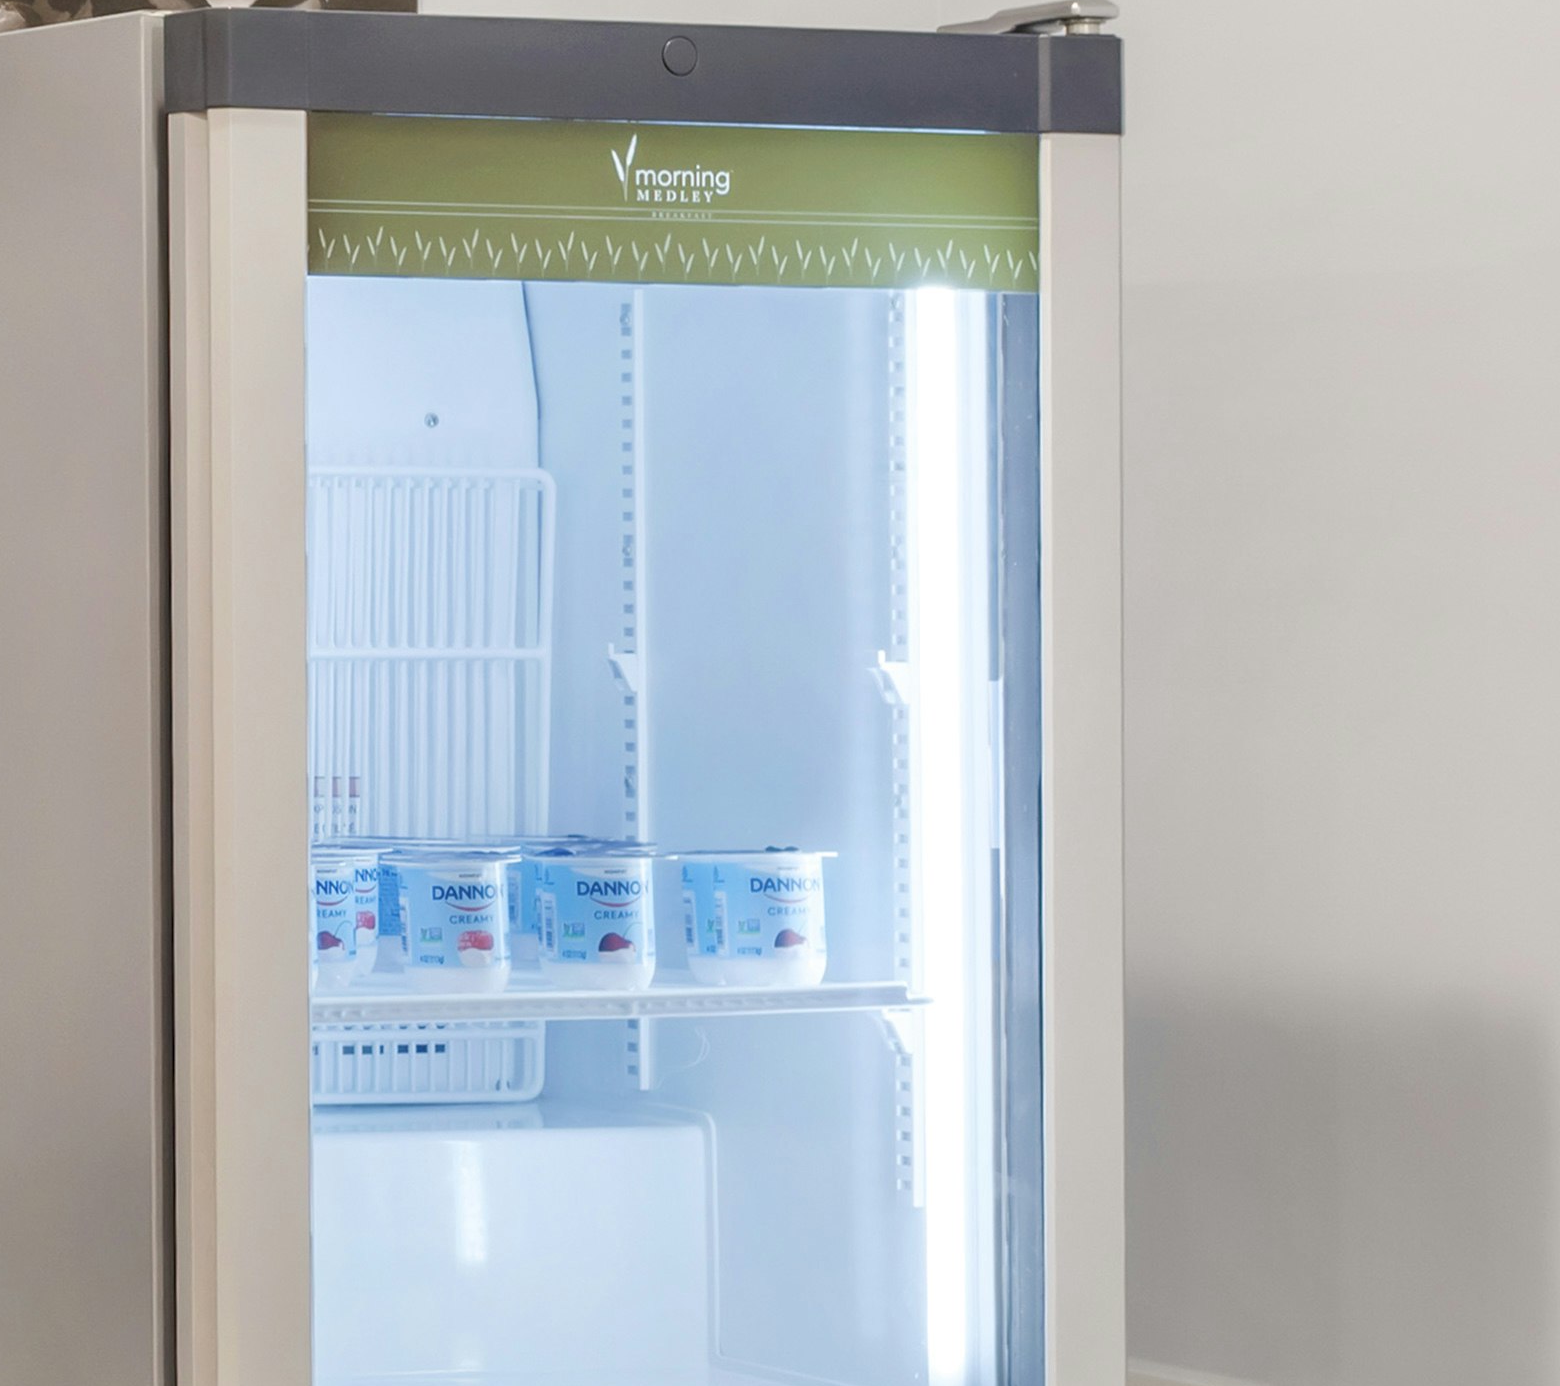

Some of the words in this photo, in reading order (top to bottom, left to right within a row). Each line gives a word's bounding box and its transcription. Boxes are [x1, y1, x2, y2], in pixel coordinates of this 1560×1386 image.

[635, 164, 731, 195] morning
[636, 189, 714, 203] MEDLEY
[315, 880, 354, 896] NNON
